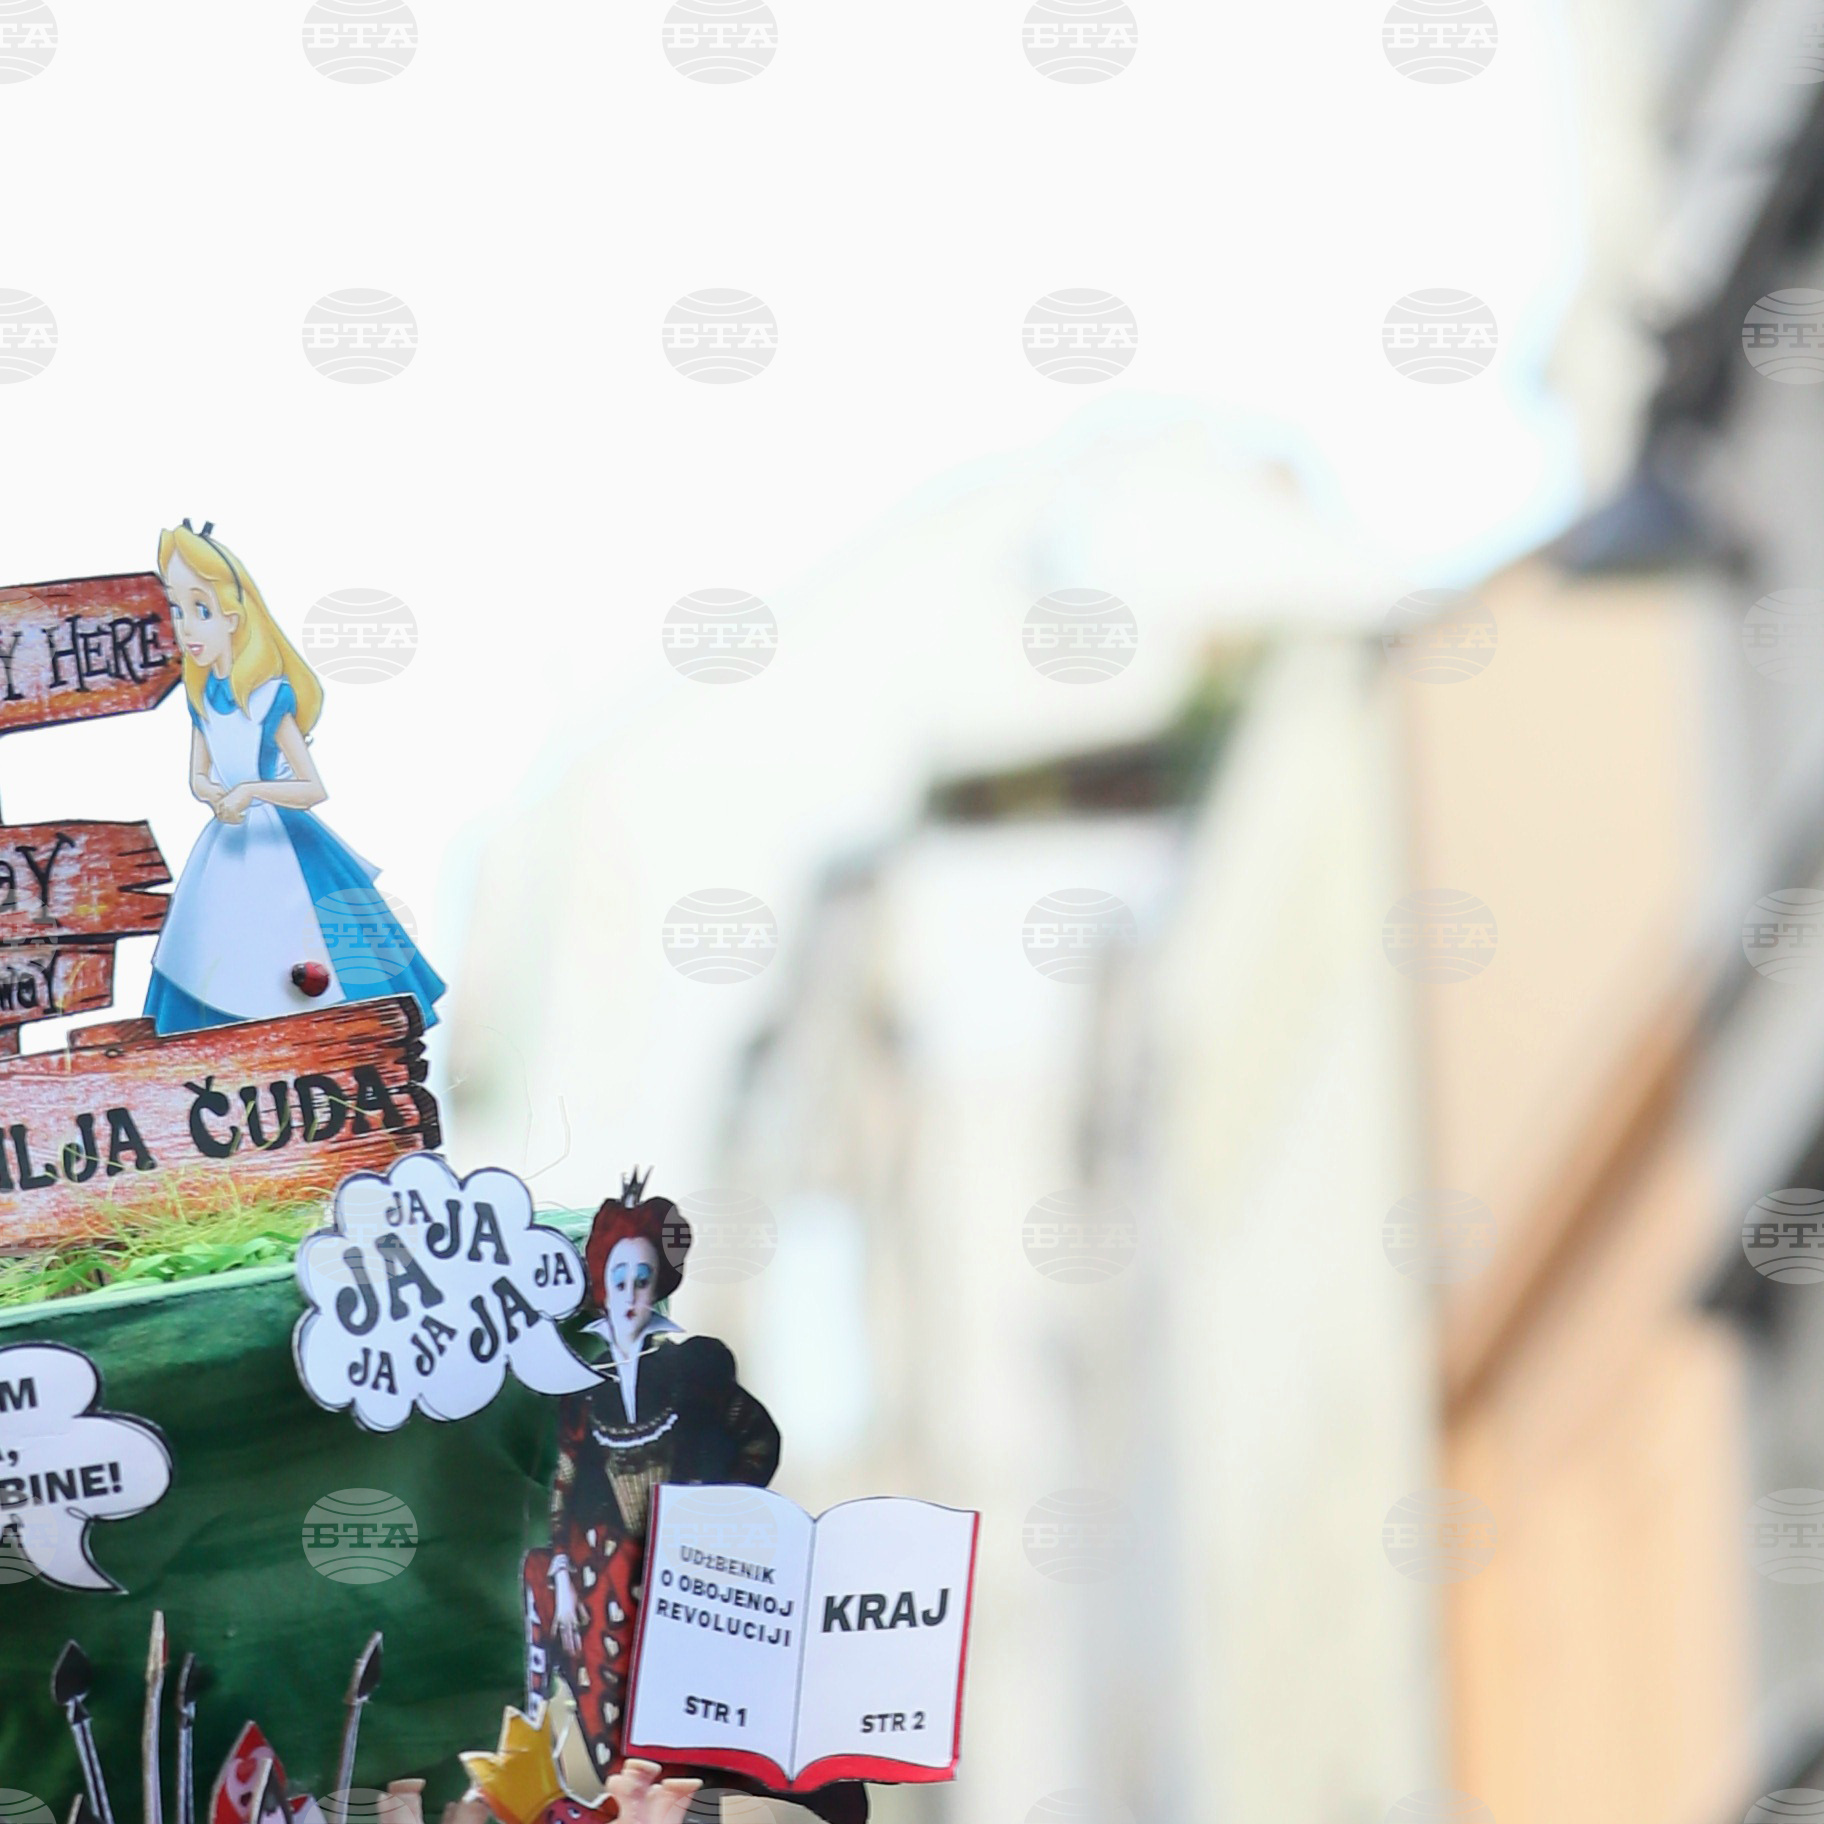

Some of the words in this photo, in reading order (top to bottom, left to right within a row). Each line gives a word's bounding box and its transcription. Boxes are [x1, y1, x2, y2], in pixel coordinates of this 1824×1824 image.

[184, 1063, 412, 1158] ČUDA
[386, 1190, 434, 1226] JA
[426, 1199, 510, 1265] JA
[336, 1233, 444, 1336] JA
[534, 1253, 574, 1287] JA
[348, 1348, 398, 1395] JA
[411, 1315, 457, 1376] JA
[469, 1276, 539, 1363] JA
[661, 1569, 674, 1588] O
[679, 1574, 794, 1618] OBOJENOJ
[821, 1588, 951, 1633] KRAJ
[656, 1599, 792, 1648] REVOLUCIJI
[684, 1695, 729, 1724] STR
[736, 1708, 747, 1727] 1
[860, 1713, 906, 1734] STR
[912, 1711, 926, 1731] 2
